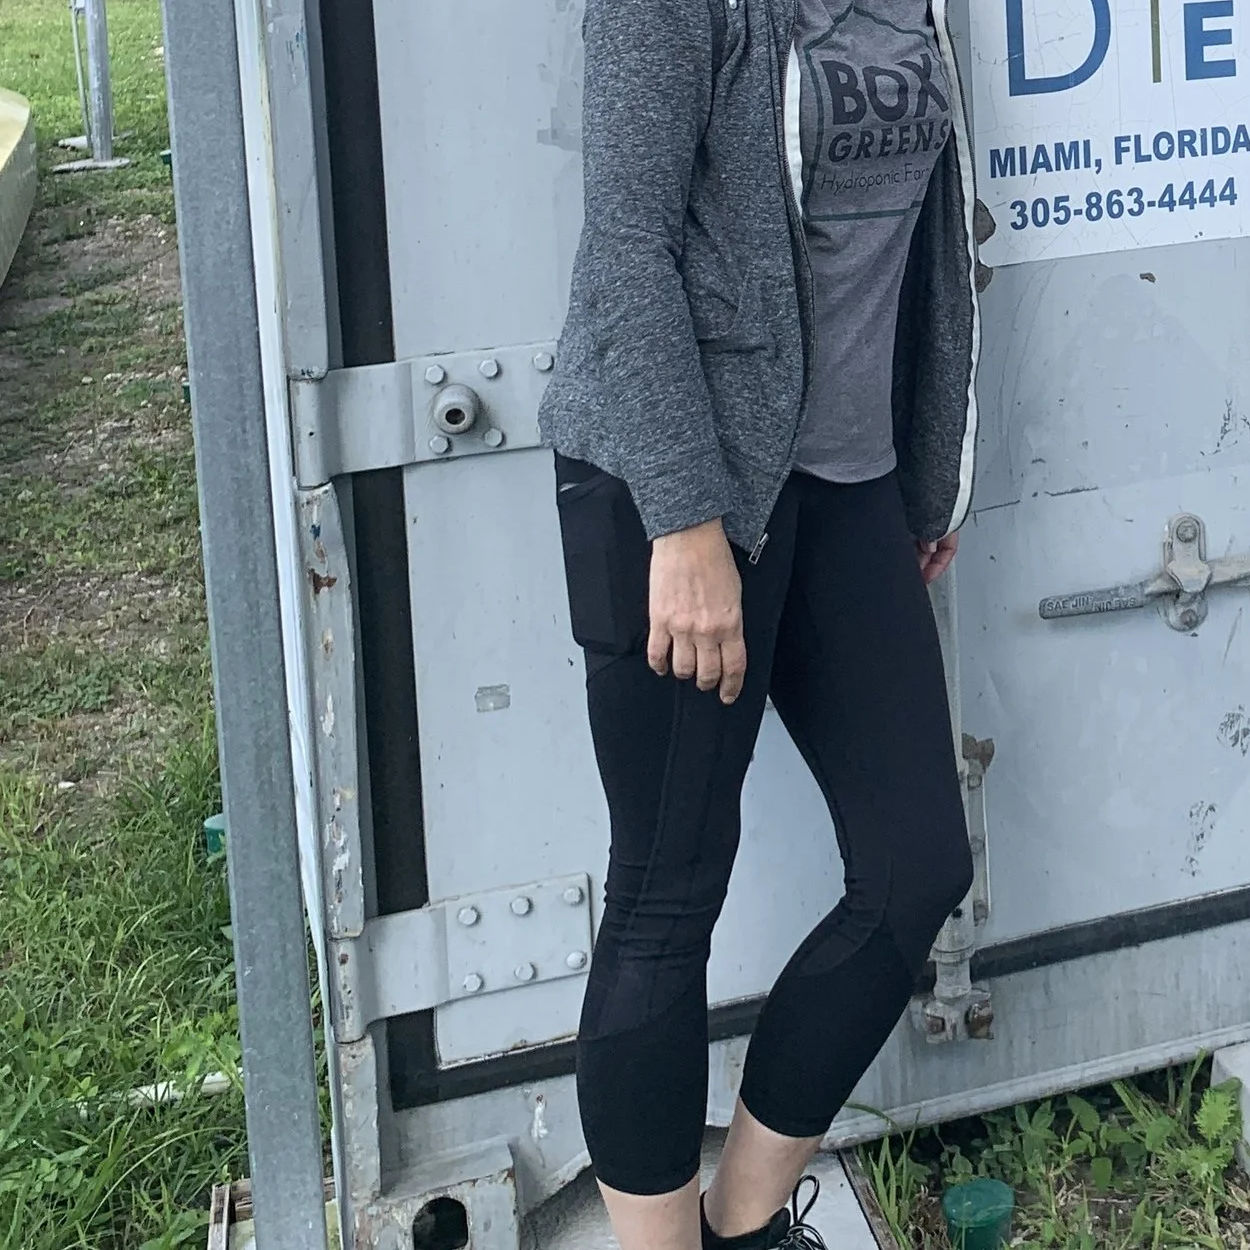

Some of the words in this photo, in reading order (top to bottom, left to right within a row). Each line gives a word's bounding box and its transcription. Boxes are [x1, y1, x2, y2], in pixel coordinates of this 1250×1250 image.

[820, 53, 949, 125] BOX
[828, 118, 949, 163] GREENS
[989, 139, 1103, 179] MIAMI,
[820, 168, 900, 195] Hydroponic
[1009, 177, 1238, 230] 305-863-4444
